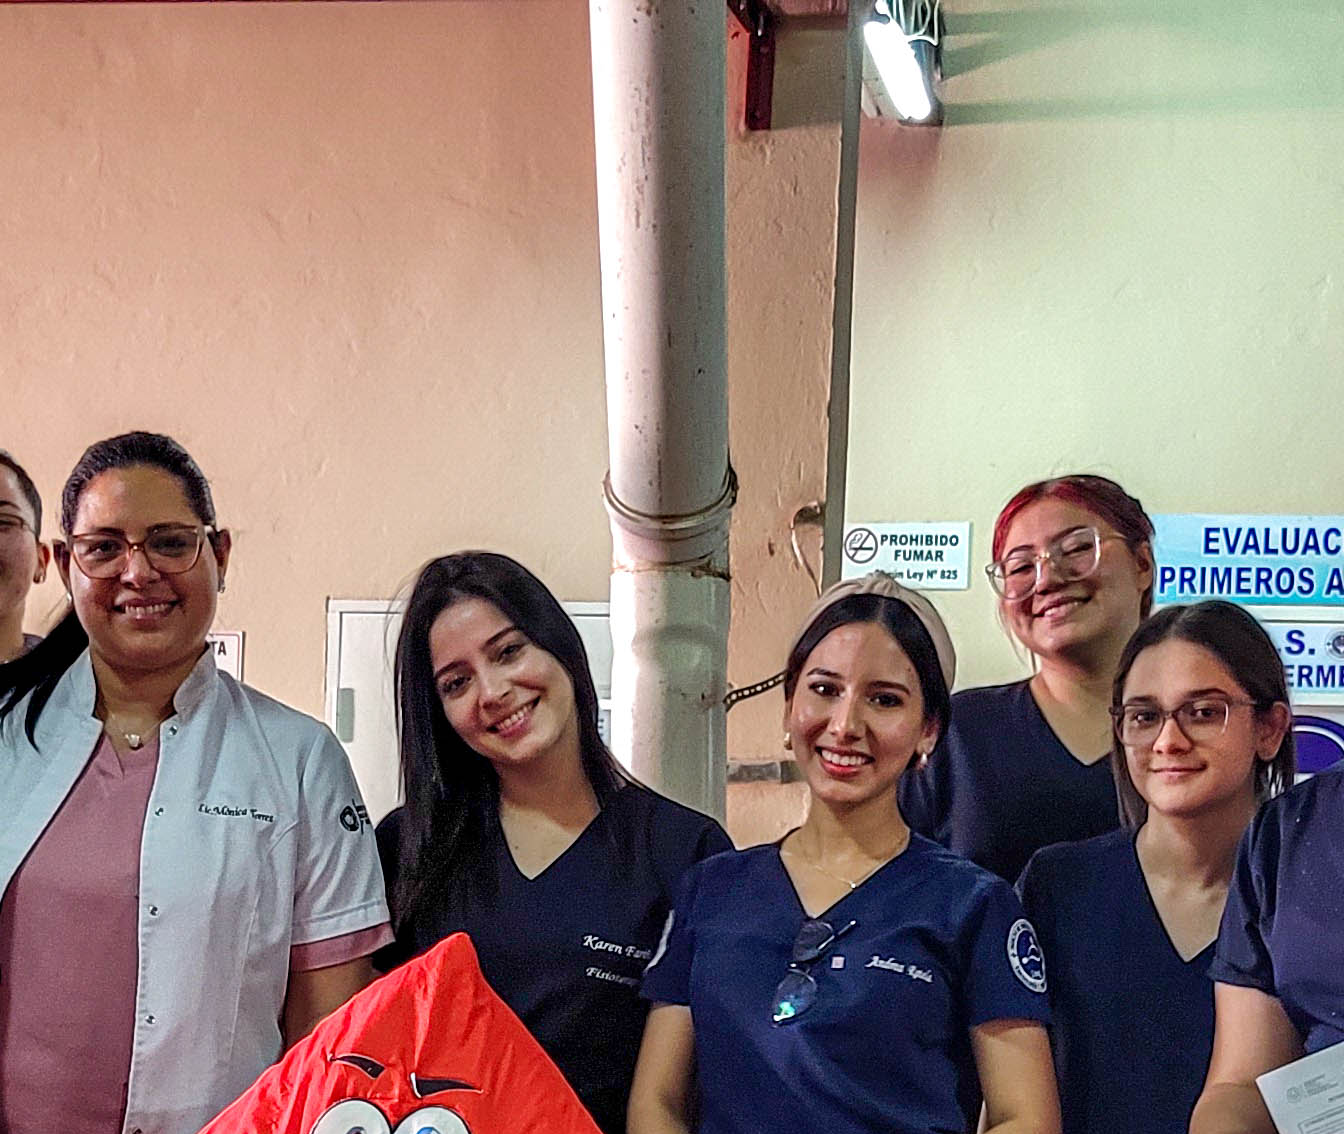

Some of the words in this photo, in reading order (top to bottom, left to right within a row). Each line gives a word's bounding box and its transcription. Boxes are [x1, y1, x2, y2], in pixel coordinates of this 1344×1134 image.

[880, 534, 959, 546] PROHIBIDO
[893, 550, 944, 562] FUMAR
[906, 569, 924, 581] Ley
[1158, 566, 1315, 596] PRIMEROS
[250, 809, 274, 823] Torres
[583, 934, 623, 954] Karen
